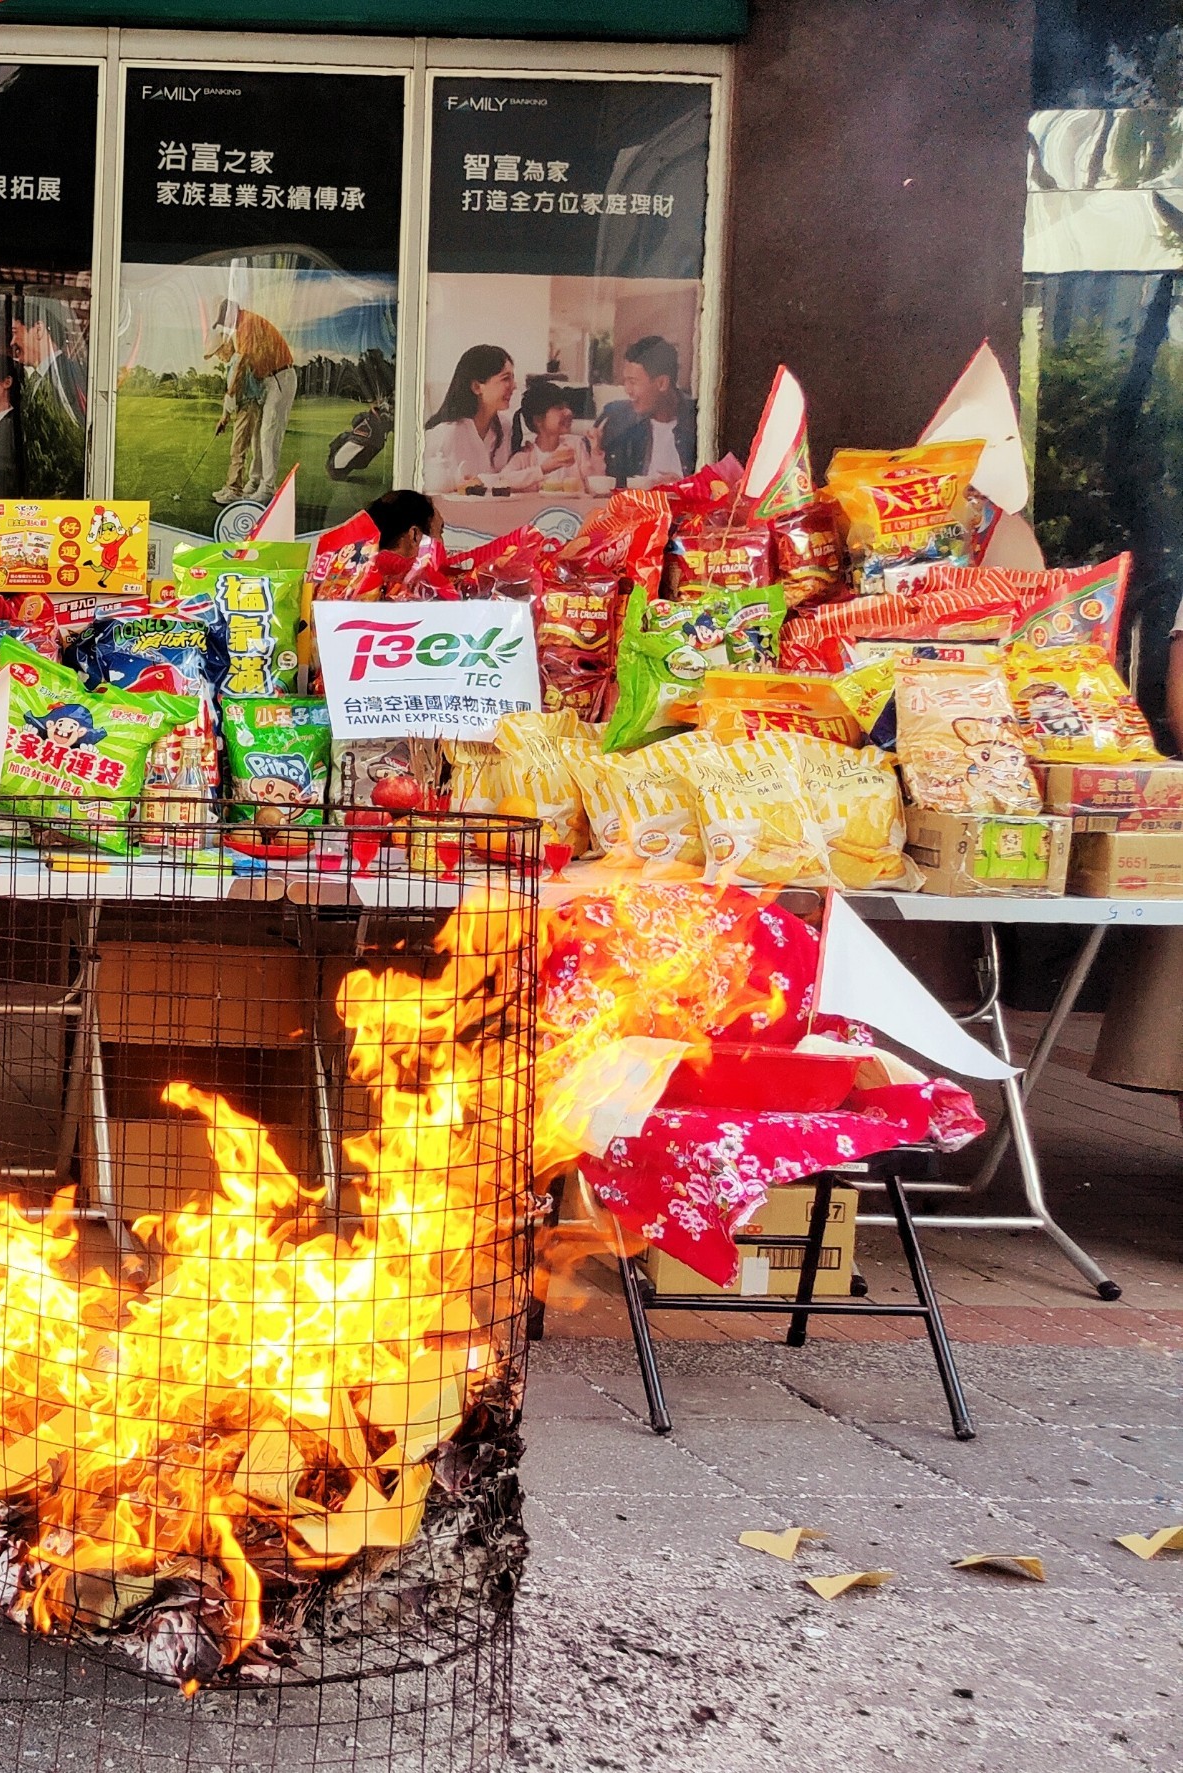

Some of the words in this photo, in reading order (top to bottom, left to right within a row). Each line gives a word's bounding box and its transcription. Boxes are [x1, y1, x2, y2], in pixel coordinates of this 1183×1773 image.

[142, 85, 201, 102] FAMILY
[203, 88, 242, 96] BANKING
[447, 97, 508, 112] FAMILY
[510, 98, 548, 106] BANKING
[157, 141, 275, 175] 治富之家
[463, 153, 570, 182] 智富為家
[156, 181, 366, 211] 家族基業永續傳承
[462, 189, 675, 218] 打造全方位家庭理財
[60, 522, 80, 583] 好運箱
[114, 617, 178, 646] LONELY
[464, 672, 503, 688] TEC
[345, 712, 401, 726] TAIWAN
[405, 712, 459, 724] EXPRESS
[248, 755, 306, 785] Prince
[1118, 856, 1148, 869] 5651
